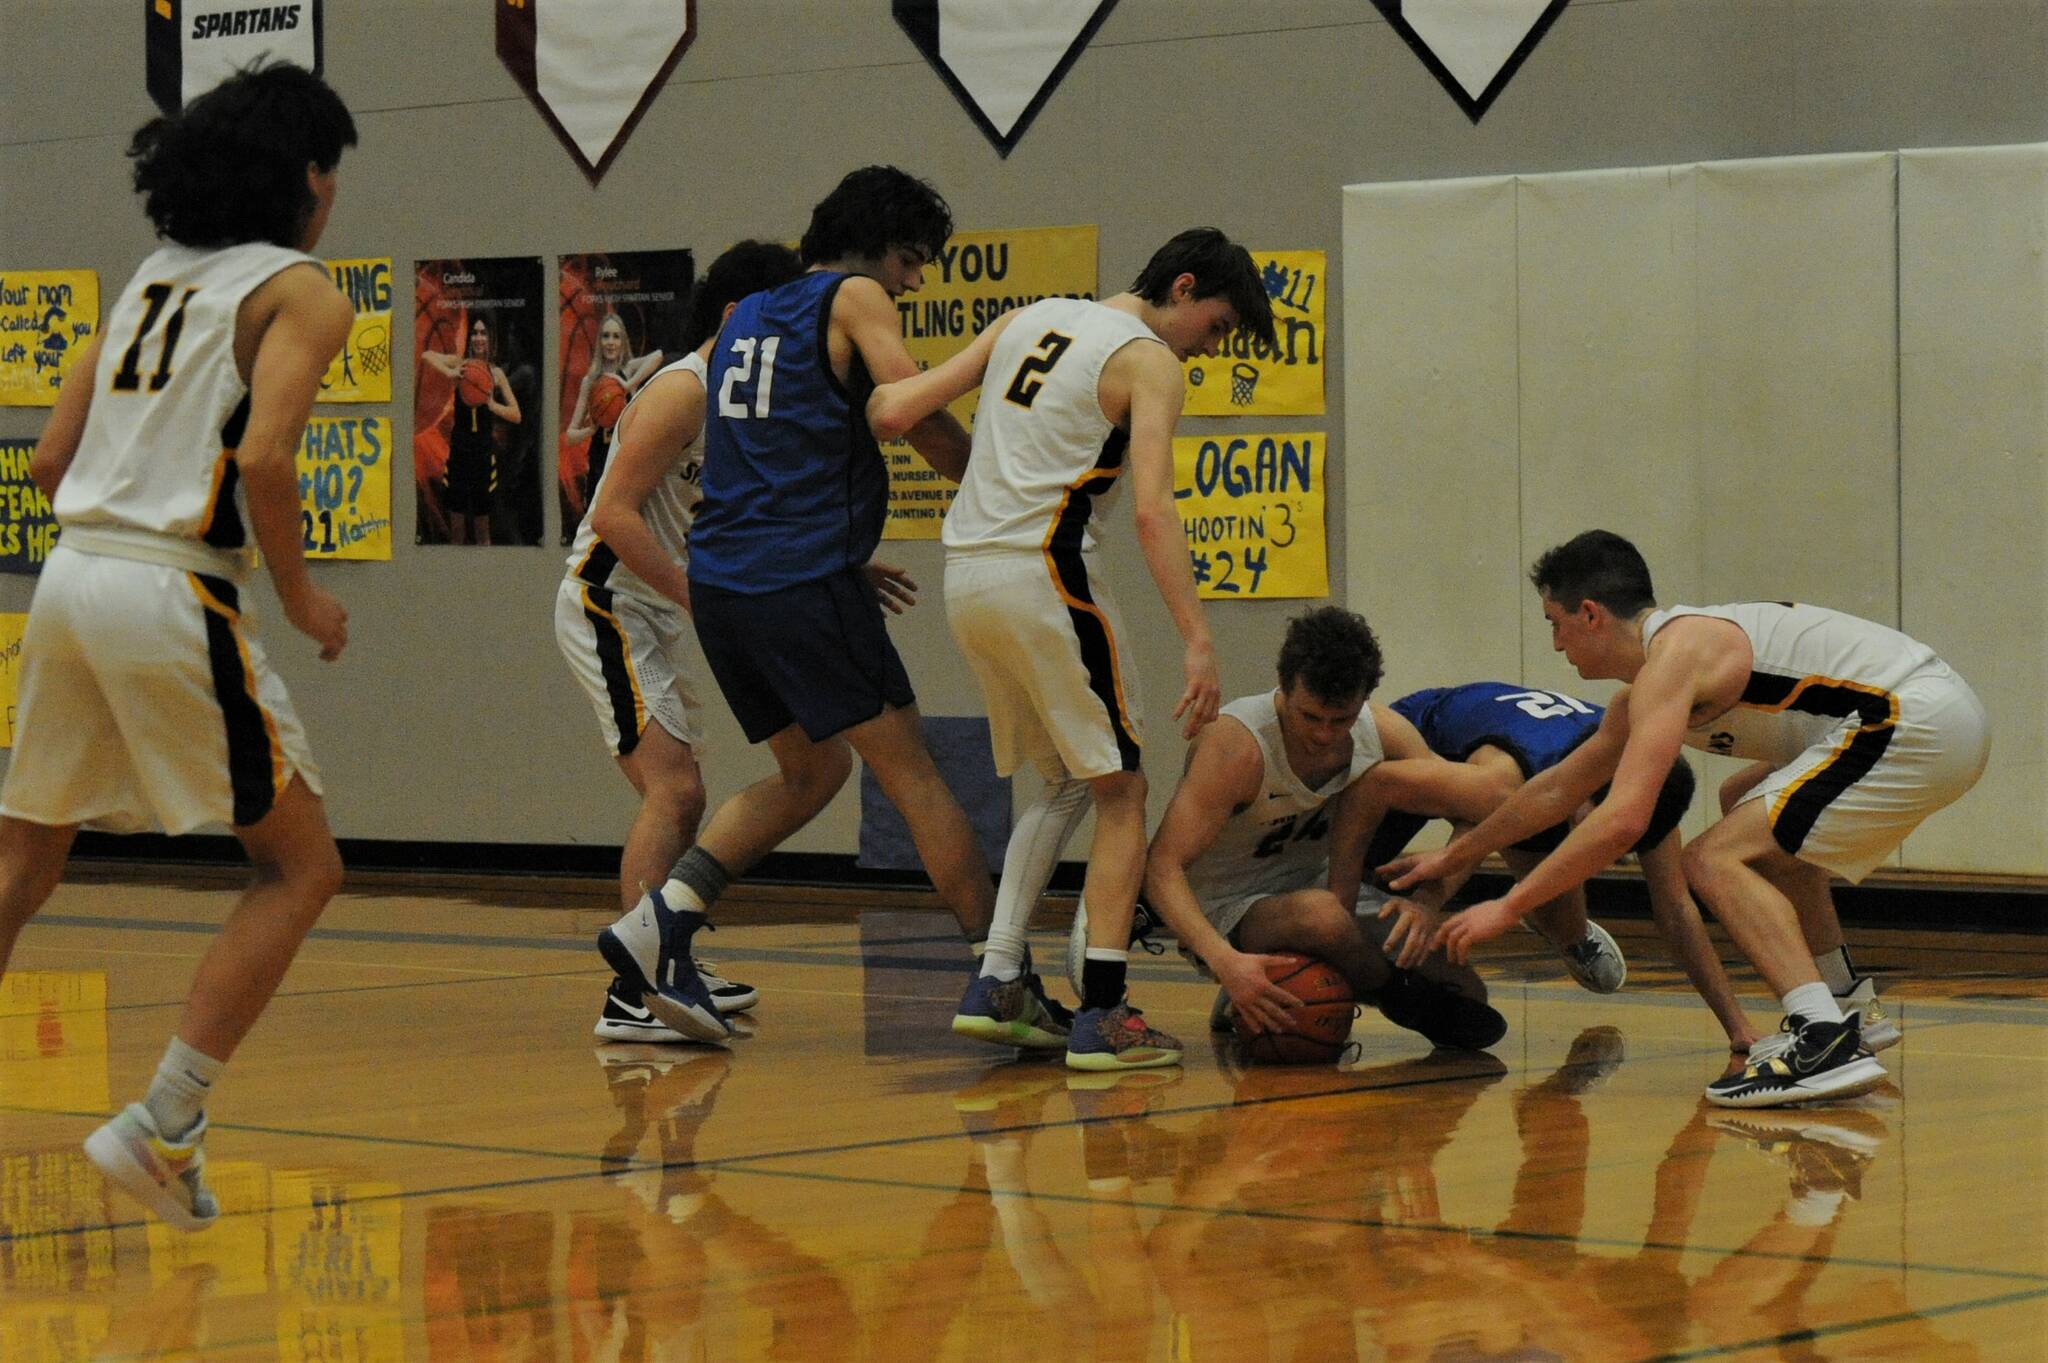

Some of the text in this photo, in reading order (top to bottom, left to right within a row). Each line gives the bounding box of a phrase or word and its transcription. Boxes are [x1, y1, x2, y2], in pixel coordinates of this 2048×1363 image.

[191, 5, 301, 40] SPARTANS
[939, 243, 1008, 283] YOU
[38, 284, 72, 307] mom
[1262, 260, 1316, 313] #11
[112, 281, 201, 395] 11
[34, 350, 63, 374] your
[718, 335, 781, 419] 21
[1003, 329, 1076, 411] 2
[892, 454, 911, 465] INN
[901, 489, 942, 501] AVENUE
[887, 507, 936, 519] PAINTING
